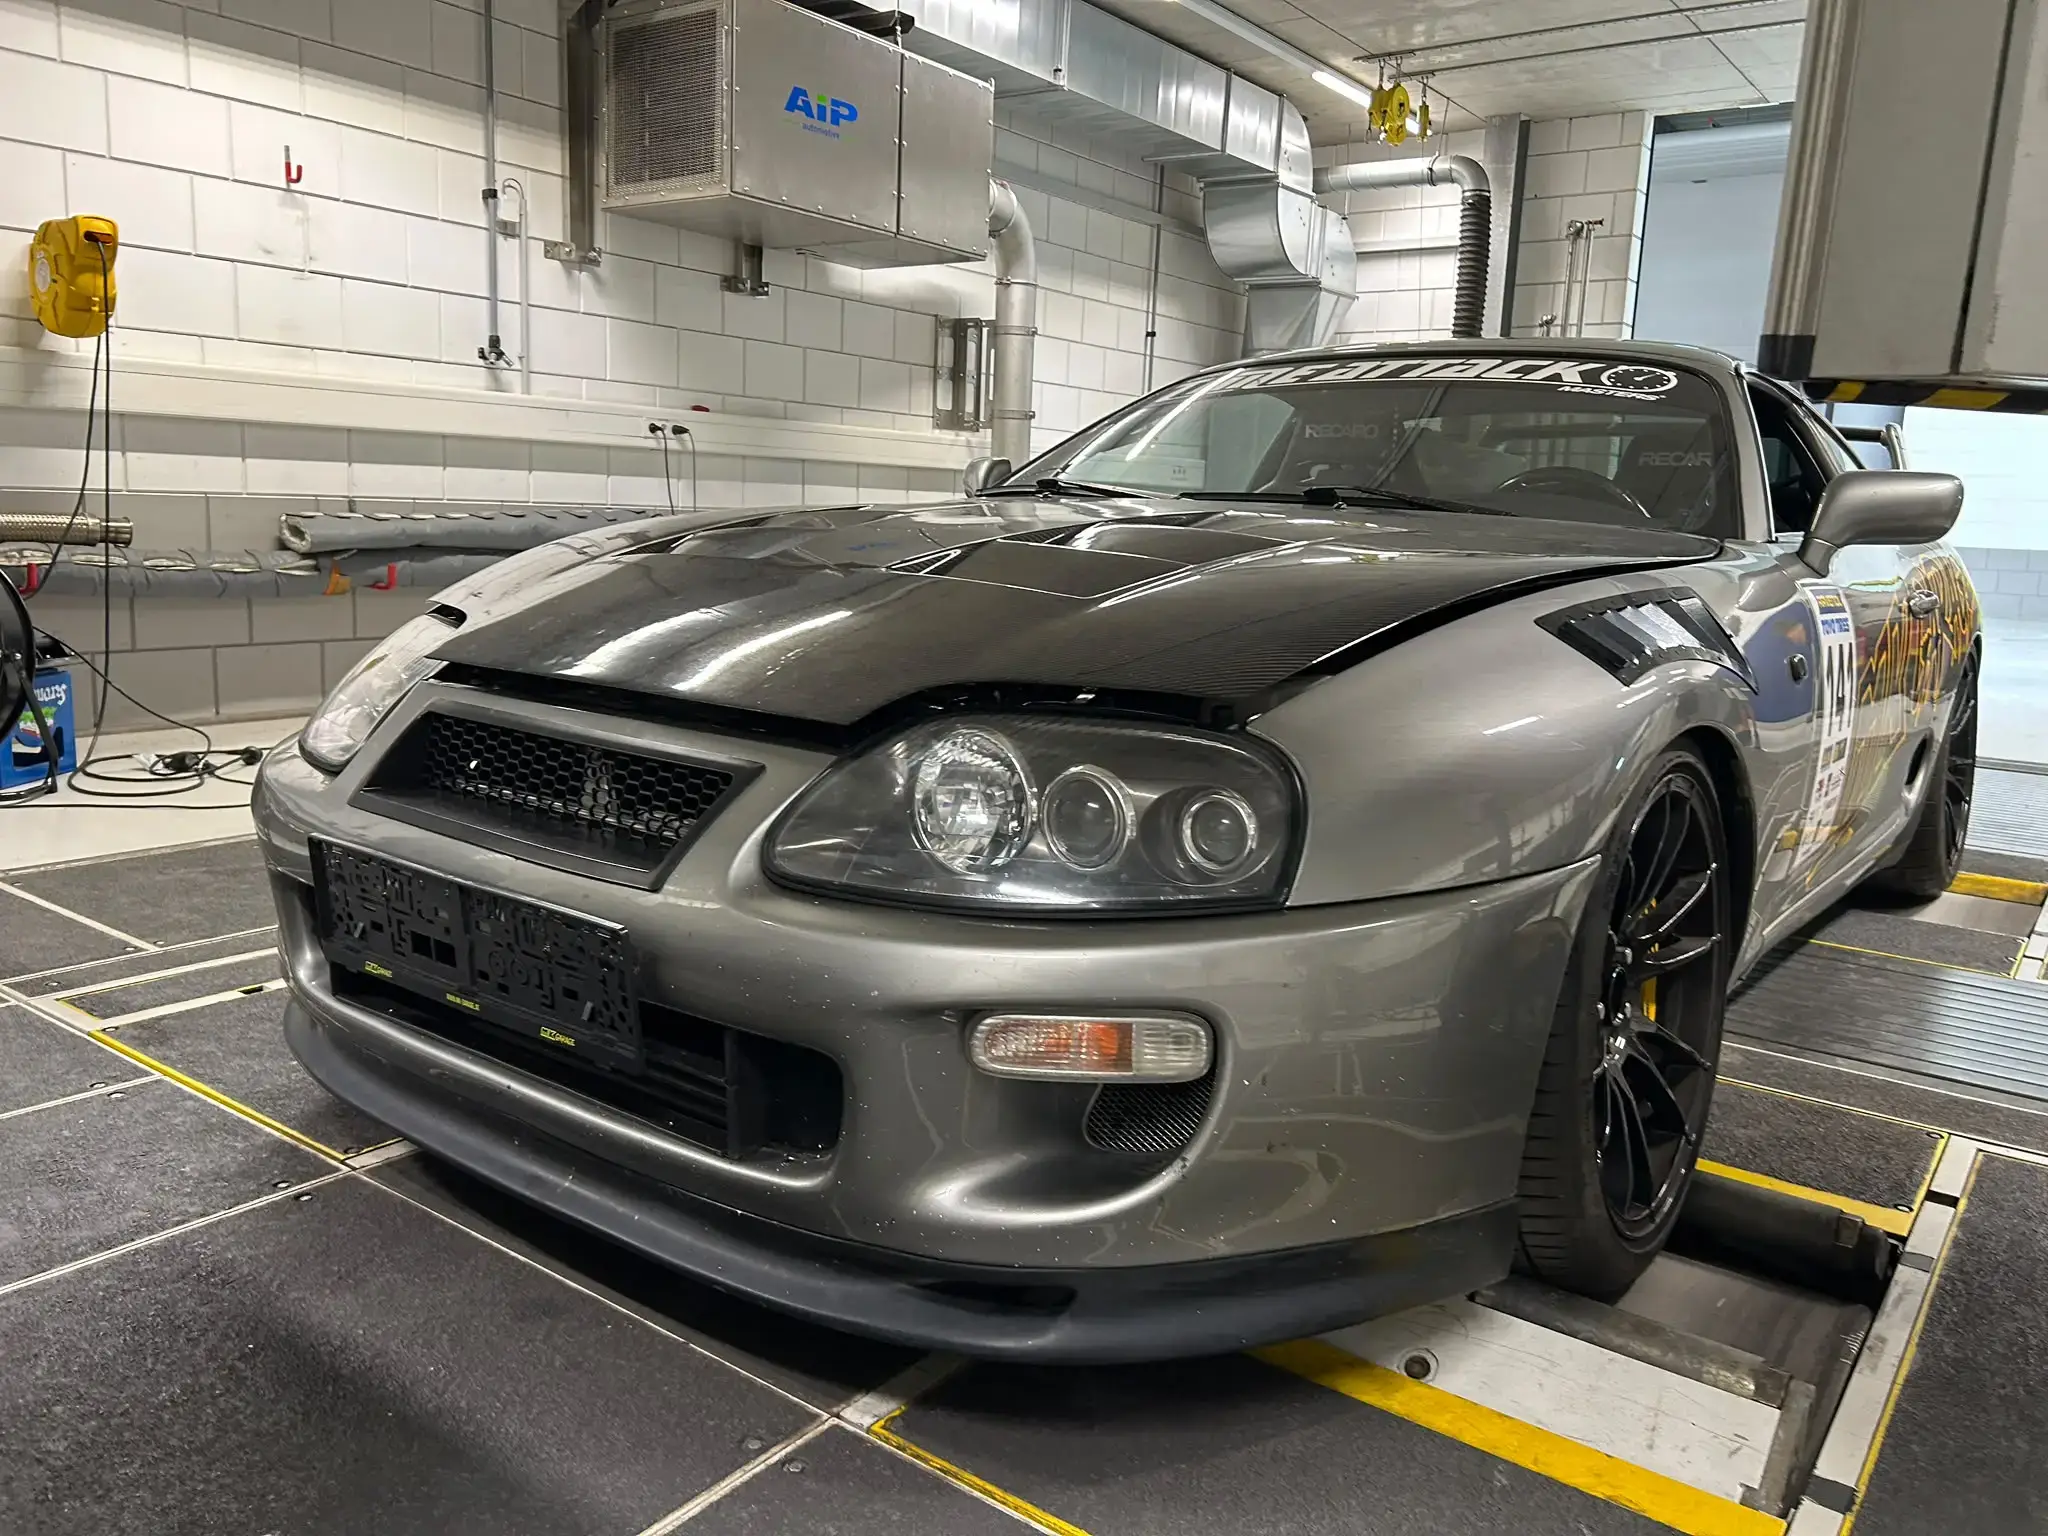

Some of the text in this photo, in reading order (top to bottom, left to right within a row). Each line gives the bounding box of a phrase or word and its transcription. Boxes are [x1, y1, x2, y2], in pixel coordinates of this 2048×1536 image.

[1556, 385, 1661, 401] MASTERS
[1304, 424, 1379, 438] RECARO
[1826, 642, 1853, 736] 141
